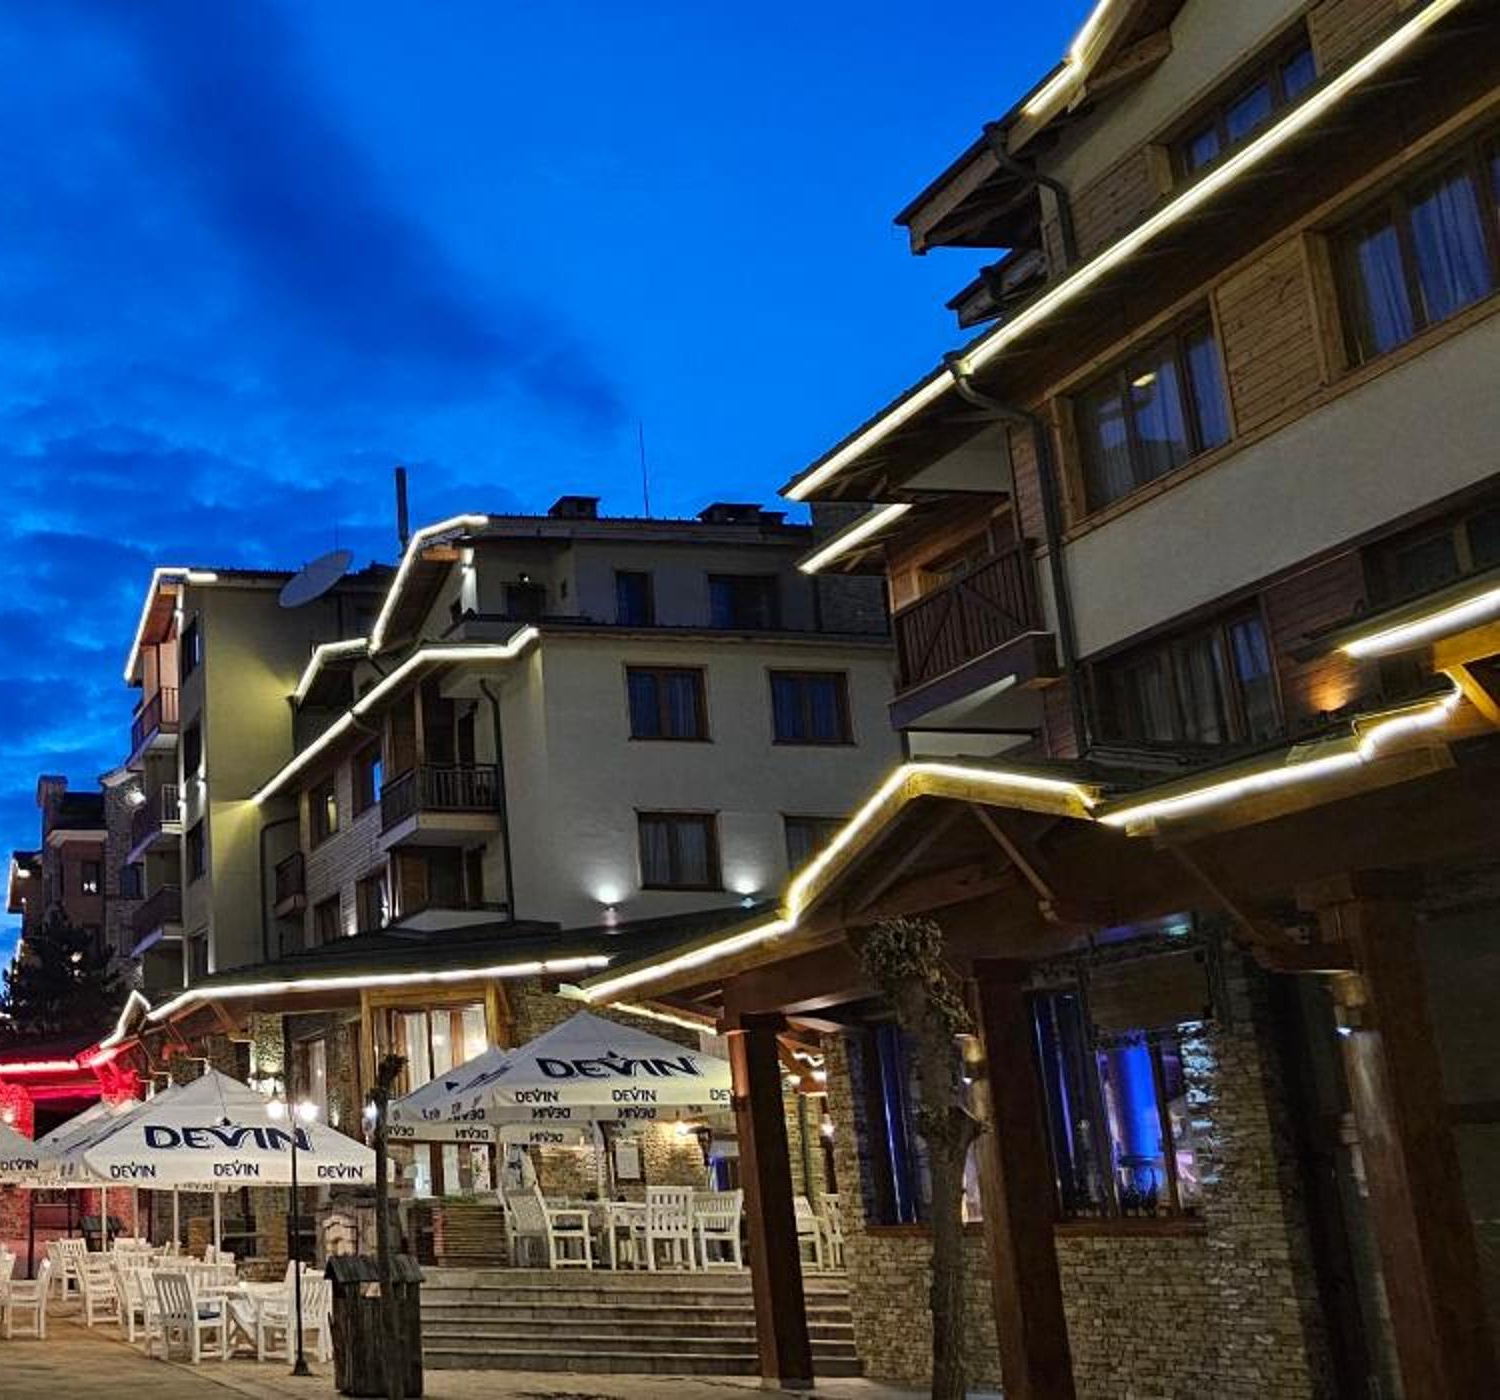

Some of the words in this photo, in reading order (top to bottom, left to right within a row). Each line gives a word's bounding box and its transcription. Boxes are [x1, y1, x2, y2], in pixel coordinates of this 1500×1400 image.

[536, 1050, 700, 1078] DEVIN
[515, 1088, 559, 1103] DEVIN
[612, 1086, 657, 1102] DEVIN
[709, 1088, 735, 1101] DEV
[144, 1117, 313, 1151] DEVIN
[0, 1158, 39, 1171] DEVIN
[110, 1162, 156, 1179] DEVIN
[213, 1159, 260, 1177] DEVIN
[317, 1163, 363, 1178] DEVIN
